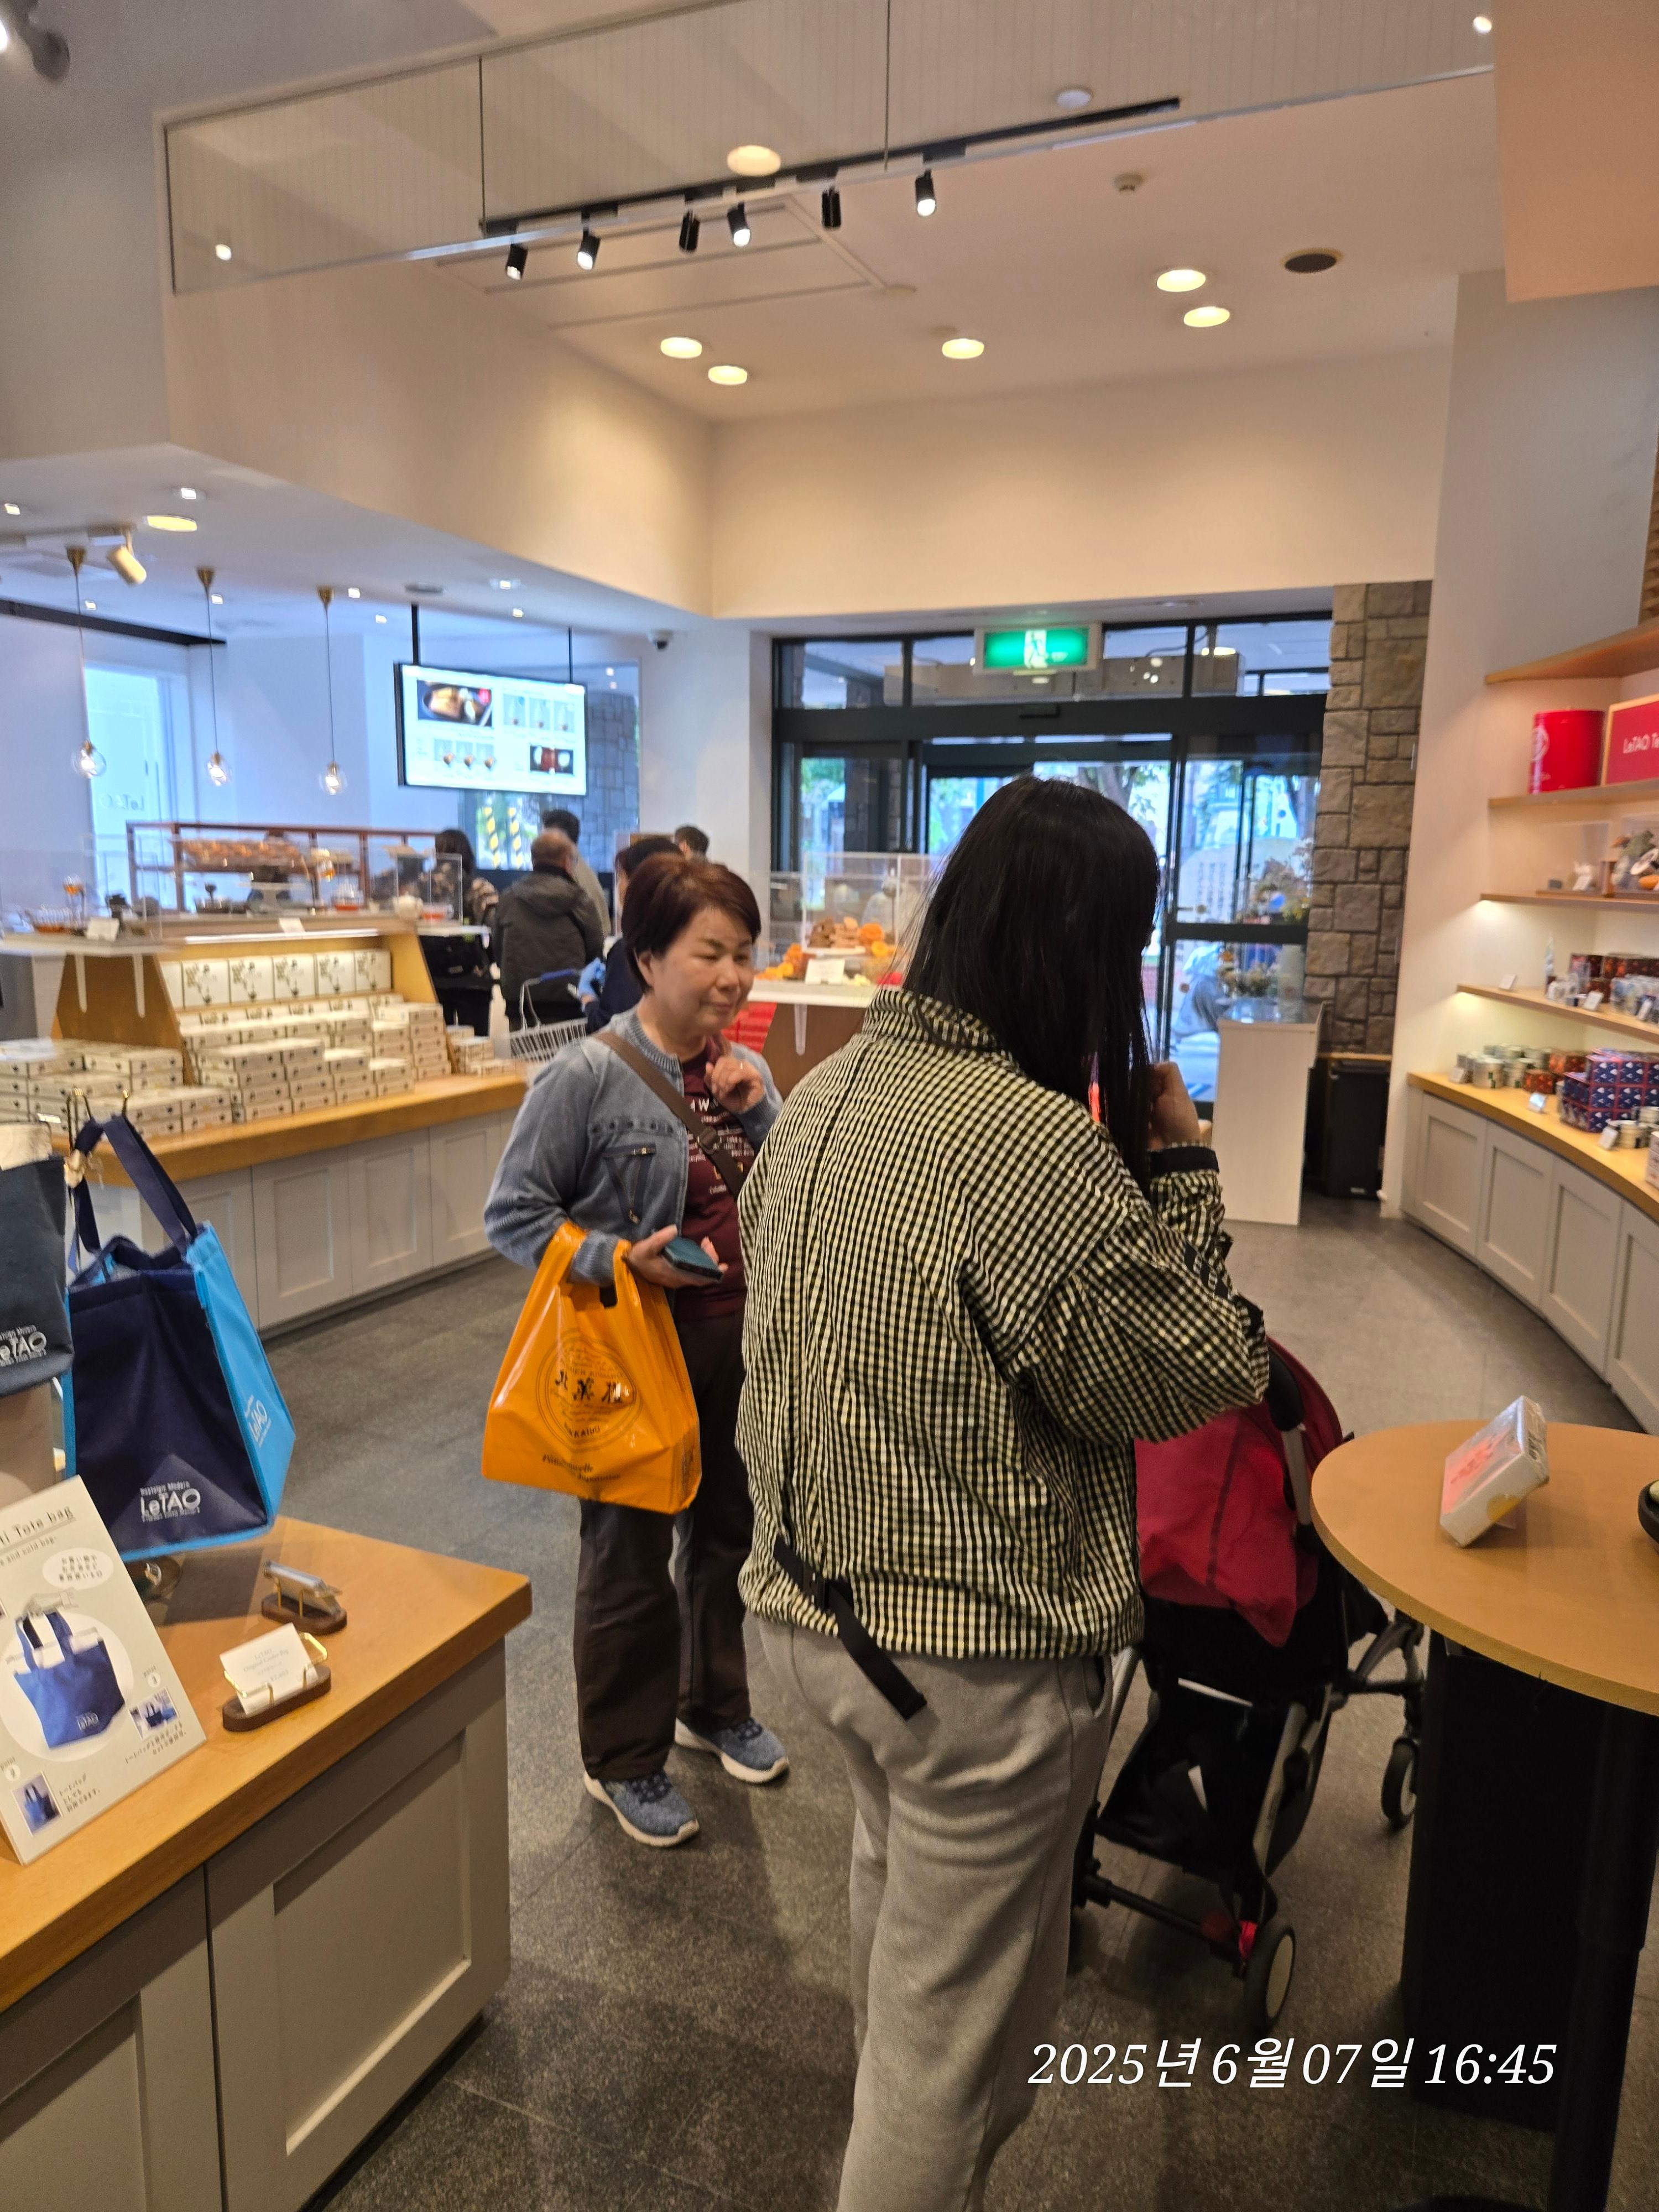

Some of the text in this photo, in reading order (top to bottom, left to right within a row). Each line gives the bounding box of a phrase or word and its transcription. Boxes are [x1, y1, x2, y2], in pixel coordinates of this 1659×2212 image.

[140, 1488, 201, 1520] LeTAO
[12, 1519, 44, 1538] Tote
[46, 1506, 74, 1522] bag
